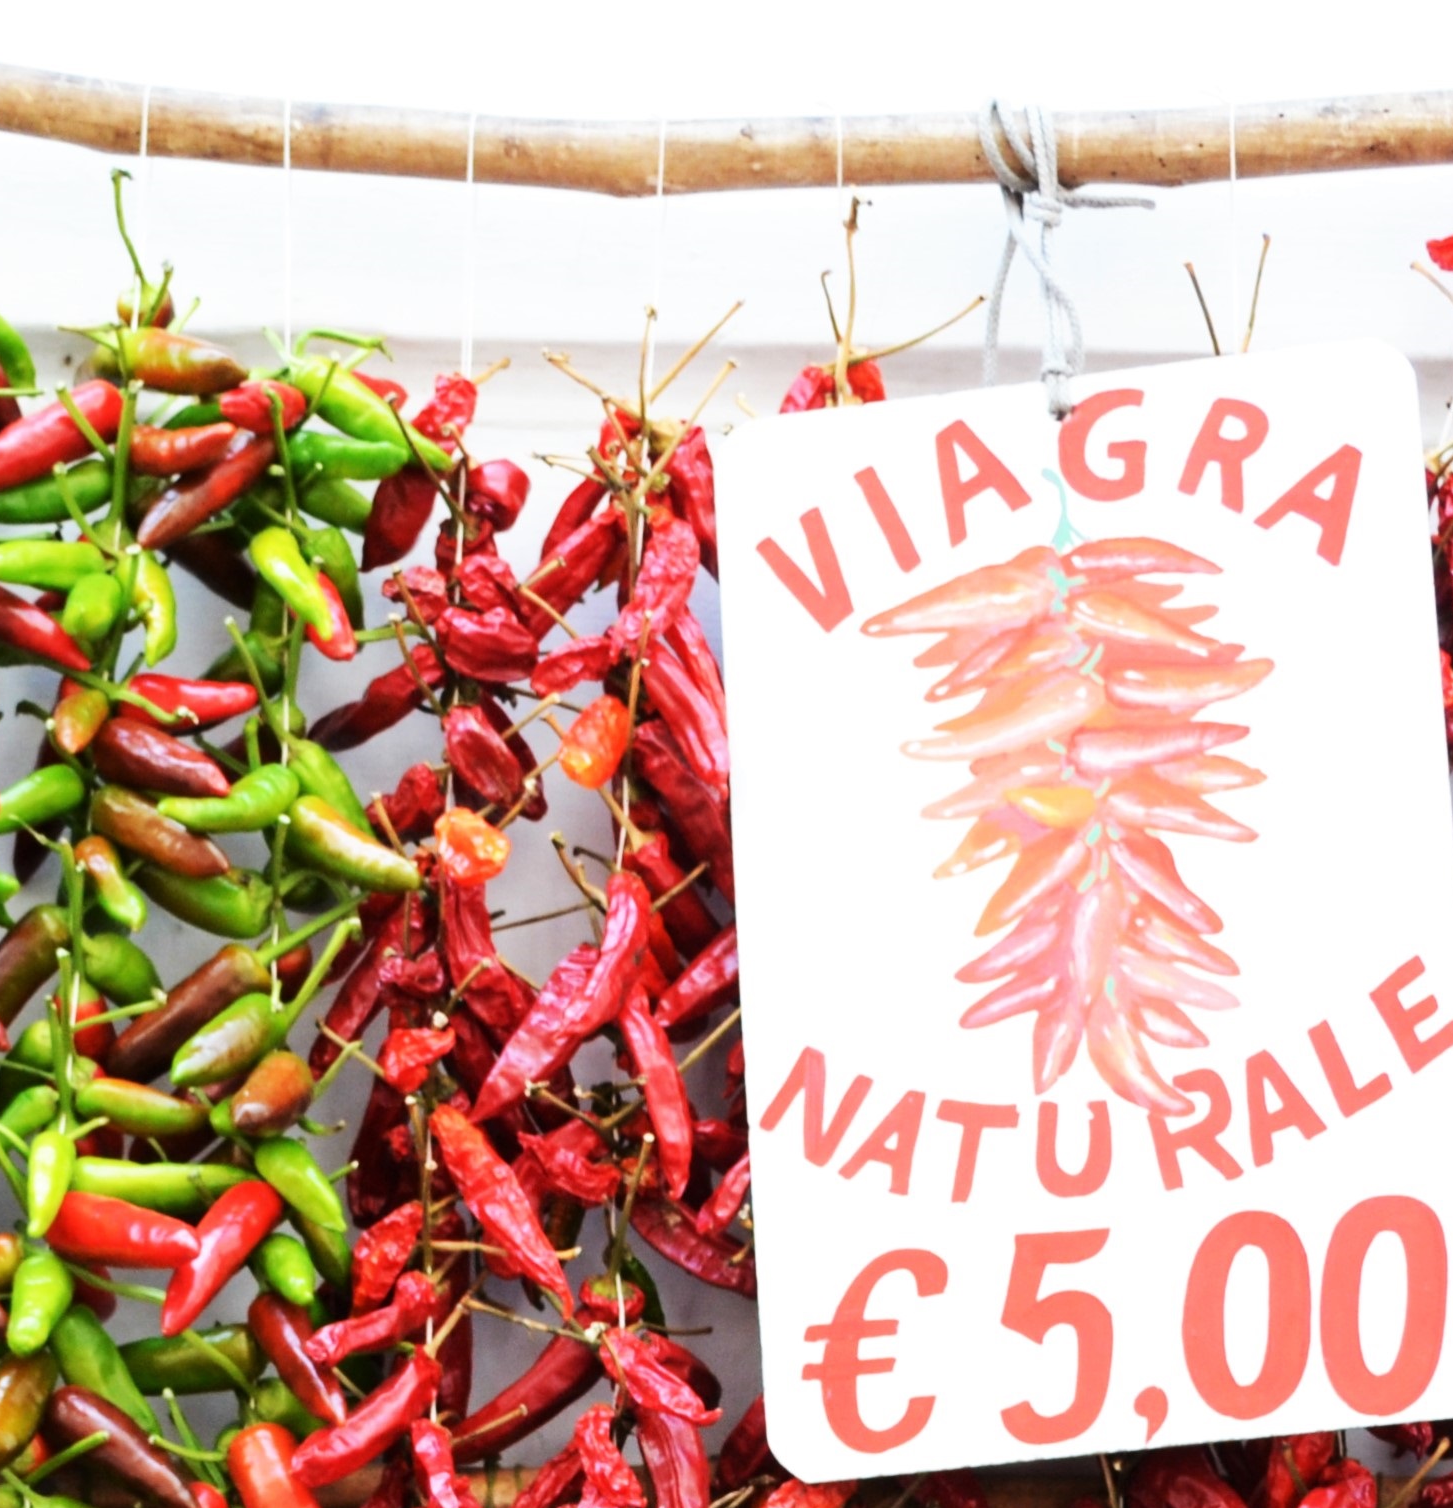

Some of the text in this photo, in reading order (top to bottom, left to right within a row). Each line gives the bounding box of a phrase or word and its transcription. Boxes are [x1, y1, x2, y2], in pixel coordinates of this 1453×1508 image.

[756, 388, 1364, 633] VIAGRA
[801, 1194, 1449, 1454] € 5,00
